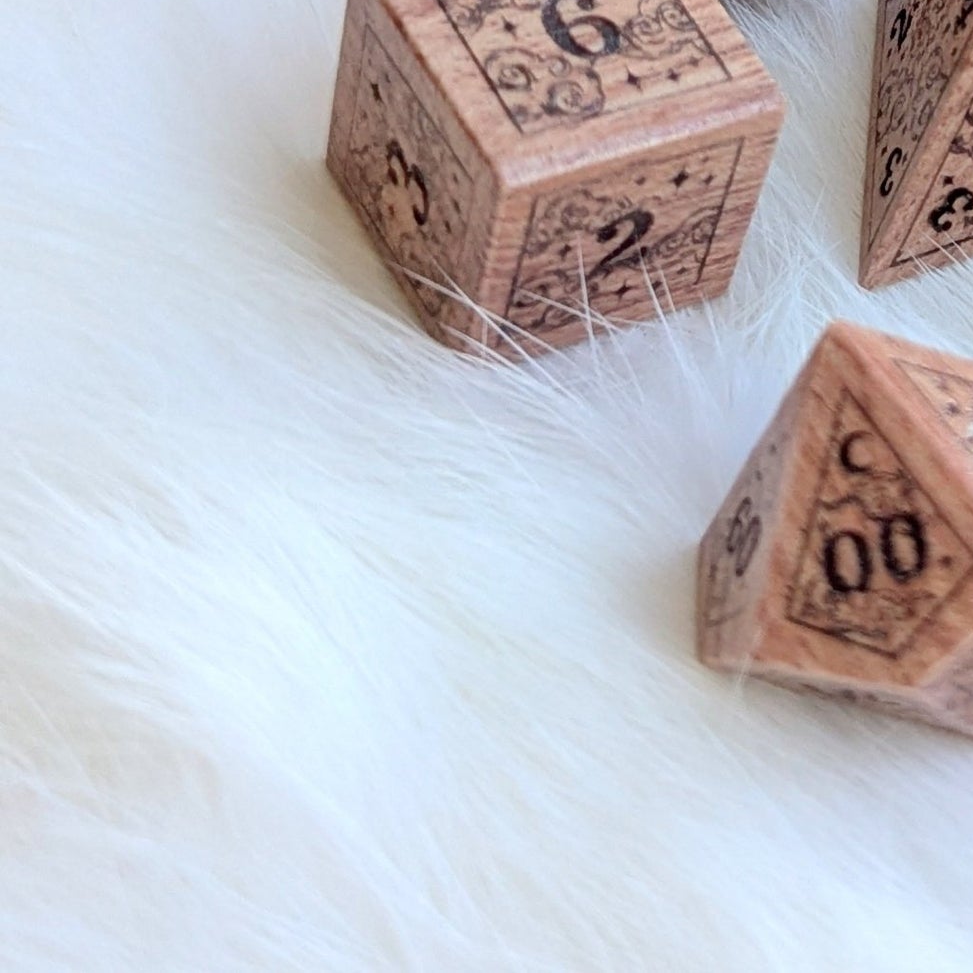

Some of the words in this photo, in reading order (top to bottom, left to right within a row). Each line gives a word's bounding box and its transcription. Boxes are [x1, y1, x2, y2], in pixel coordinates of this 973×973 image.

[386, 140, 430, 226] 3
[586, 209, 654, 280] 2
[822, 513, 928, 594] 00
